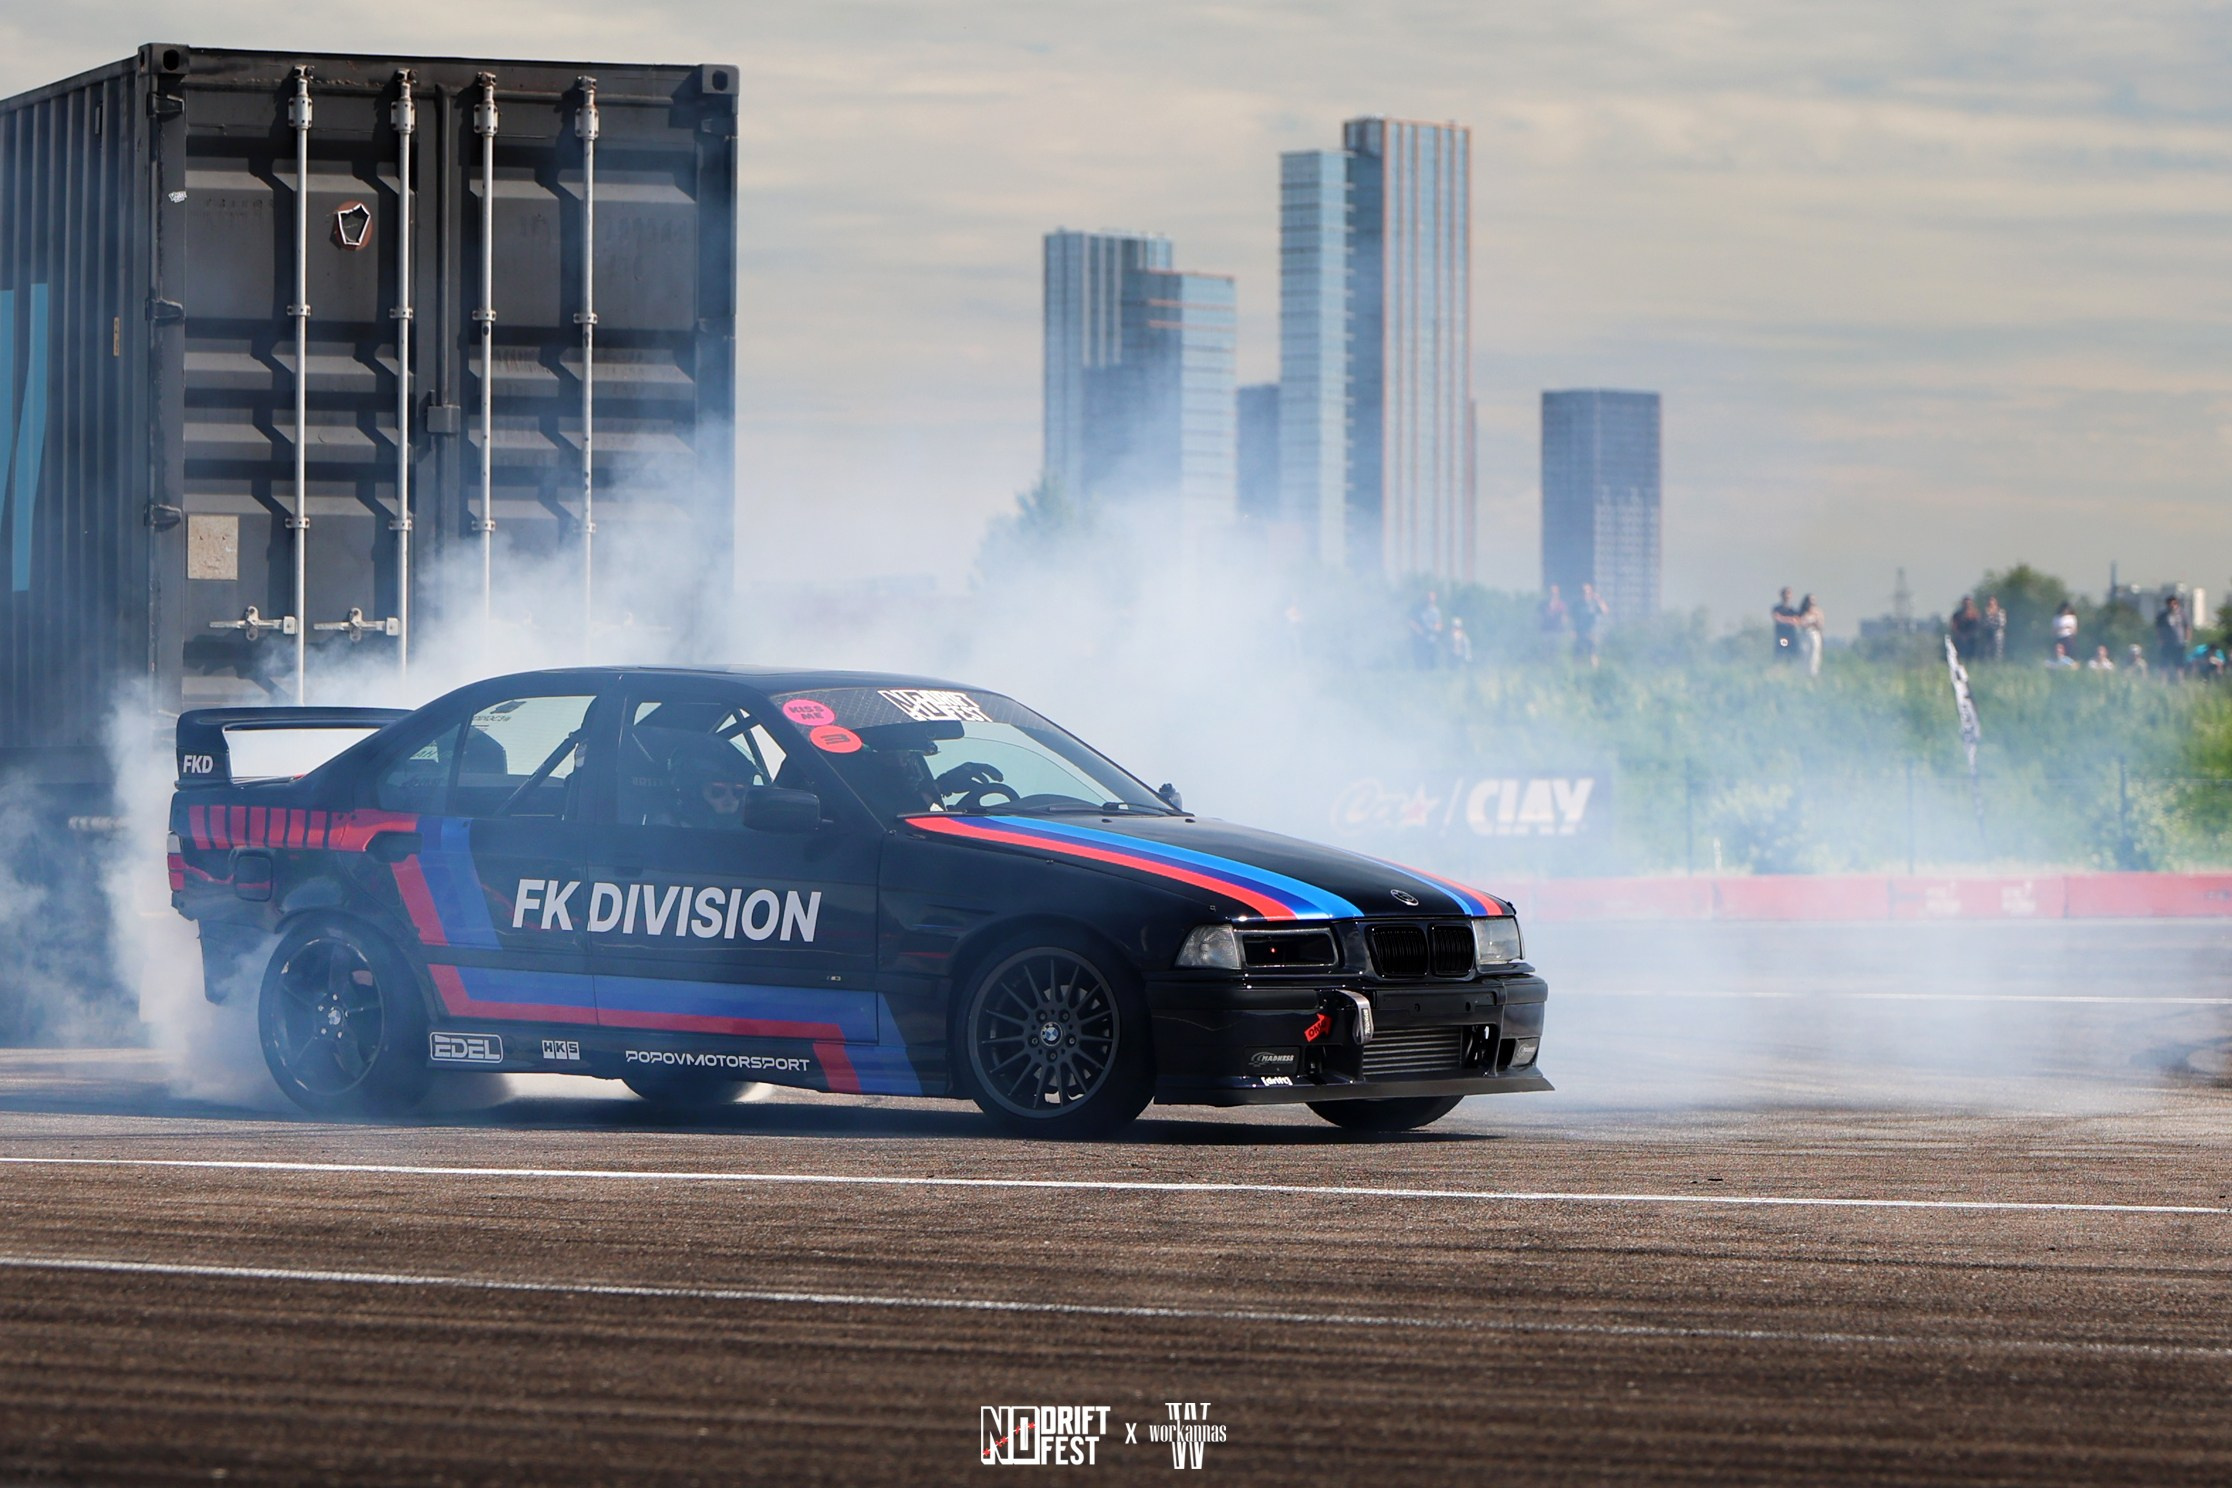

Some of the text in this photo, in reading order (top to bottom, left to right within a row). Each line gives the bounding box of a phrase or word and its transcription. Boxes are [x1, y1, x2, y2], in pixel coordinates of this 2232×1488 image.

[788, 704, 825, 714] KISS
[800, 712, 825, 720] ME
[183, 754, 214, 774] FKD
[512, 879, 822, 943] FK DIVISION
[434, 1034, 501, 1061] EDEL
[542, 1040, 580, 1060] HKS
[625, 1050, 810, 1072] POPOVMOTORSPORT
[1261, 1054, 1295, 1062] MADNESS
